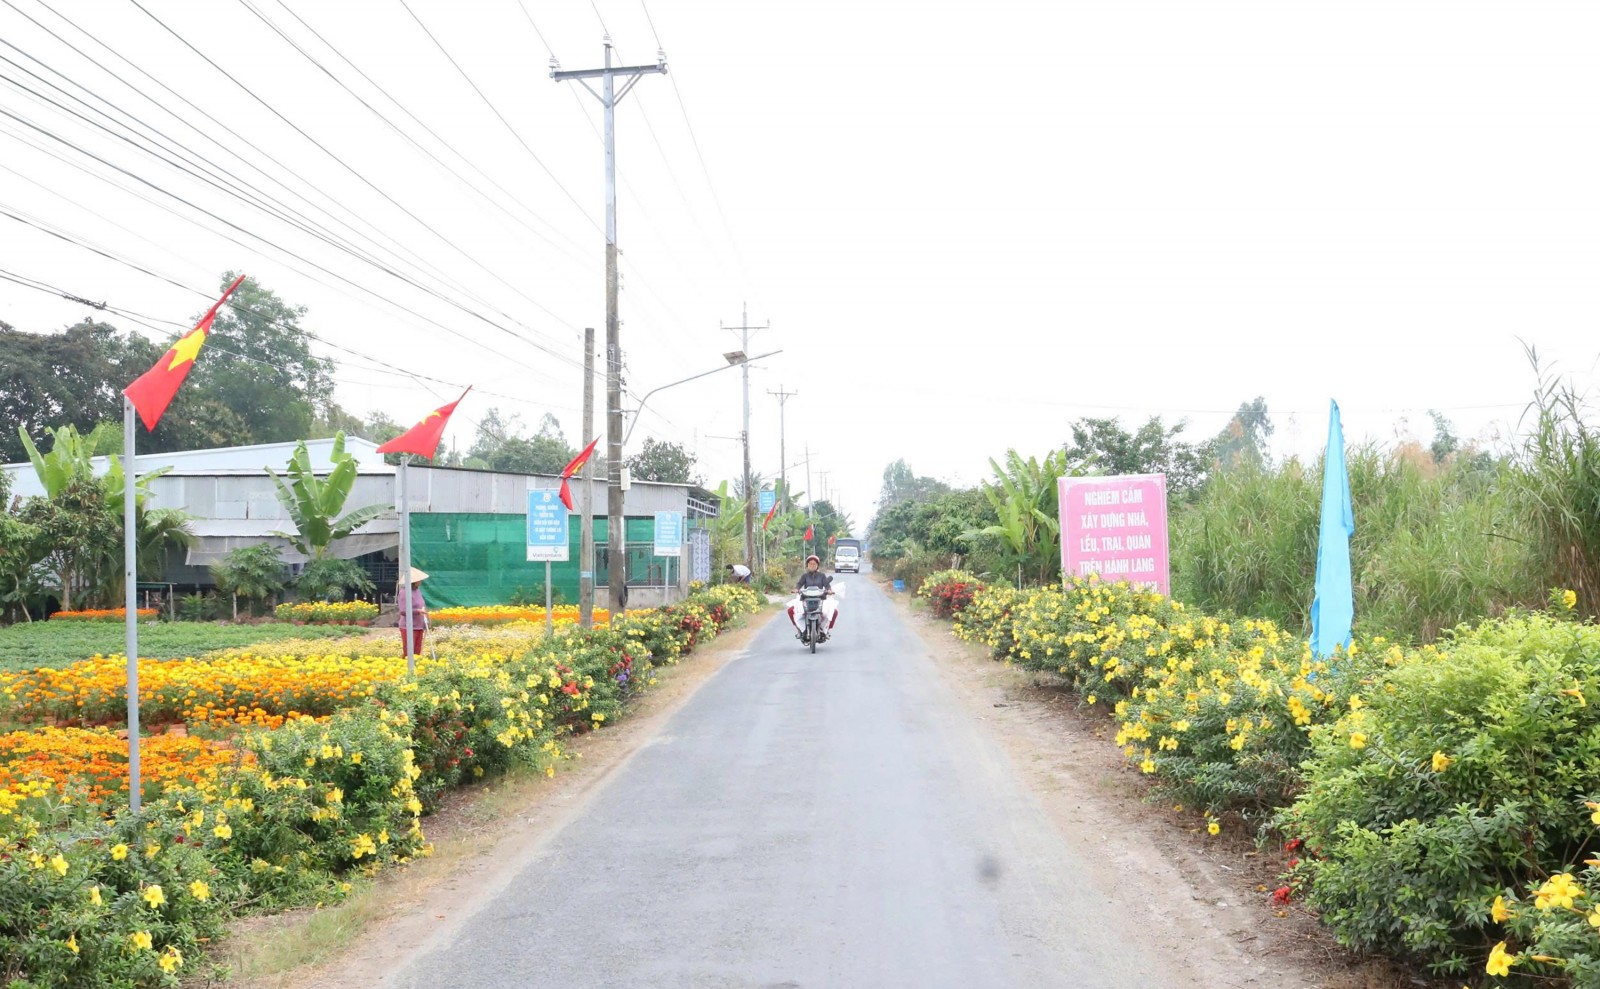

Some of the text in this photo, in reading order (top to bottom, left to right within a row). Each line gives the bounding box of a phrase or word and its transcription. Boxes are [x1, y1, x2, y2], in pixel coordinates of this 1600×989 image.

[1084, 485, 1143, 506] NGHIÊM CẤM
[1081, 509, 1149, 531] XÂY DỰNG NHÀ,
[1102, 536, 1124, 553] TRẠI,
[1126, 532, 1151, 551] QUÁN
[1080, 556, 1155, 575] TRÊN HÀNH LANG
